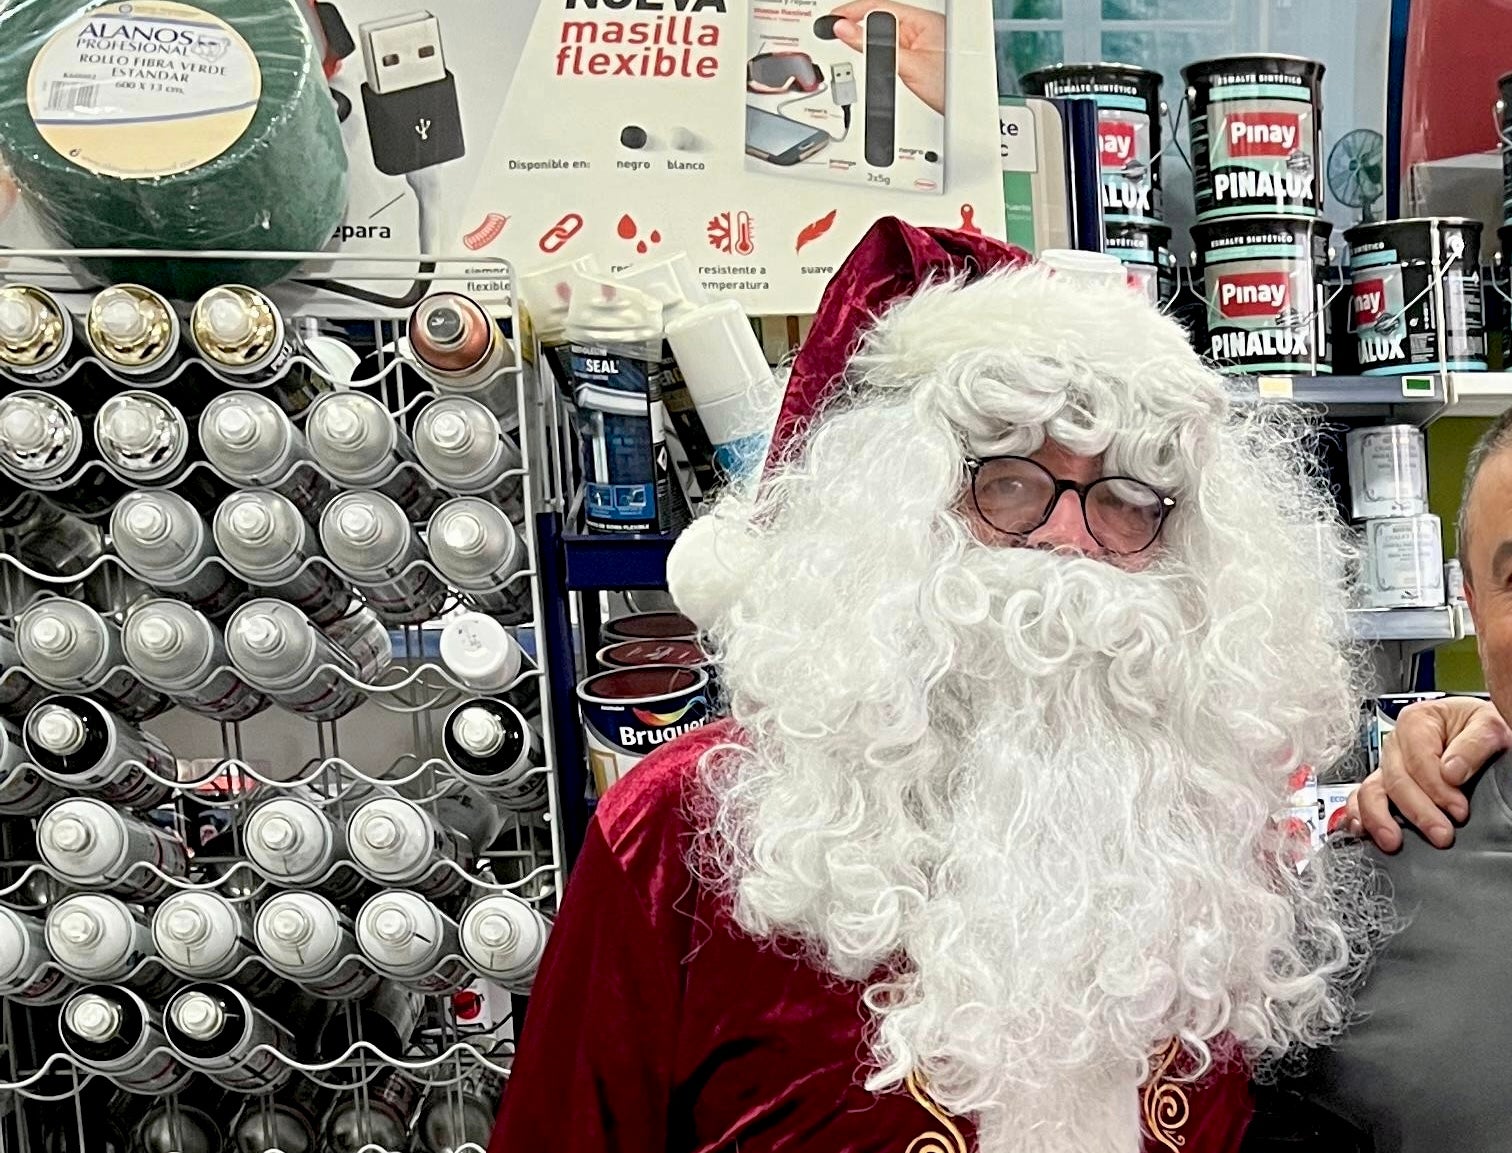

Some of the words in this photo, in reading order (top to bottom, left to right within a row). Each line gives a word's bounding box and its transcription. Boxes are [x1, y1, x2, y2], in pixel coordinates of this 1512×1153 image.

[78, 22, 194, 46] ALANOS
[560, 15, 720, 47] masilla
[76, 38, 188, 57] PROFESIONAL
[79, 53, 129, 66] ROLLO
[134, 54, 174, 70] FIBRA
[181, 61, 227, 77] VERDE
[556, 46, 719, 78] flexible
[111, 67, 189, 83] ESTANDAR
[1000, 119, 1019, 137] te
[1230, 121, 1297, 149] Pinay
[508, 160, 569, 170] Disponible
[572, 160, 591, 169] en:
[616, 160, 651, 171] negro
[667, 160, 705, 170] blanco
[1214, 170, 1314, 201] PINALUX
[699, 265, 756, 275] resistente
[759, 267, 767, 275] a
[801, 266, 833, 275] suave
[467, 281, 511, 292] flexible
[702, 280, 769, 291] emperatura
[1221, 283, 1286, 307] Pinay
[1211, 329, 1308, 360] PINALUX
[586, 358, 619, 374] SEAL
